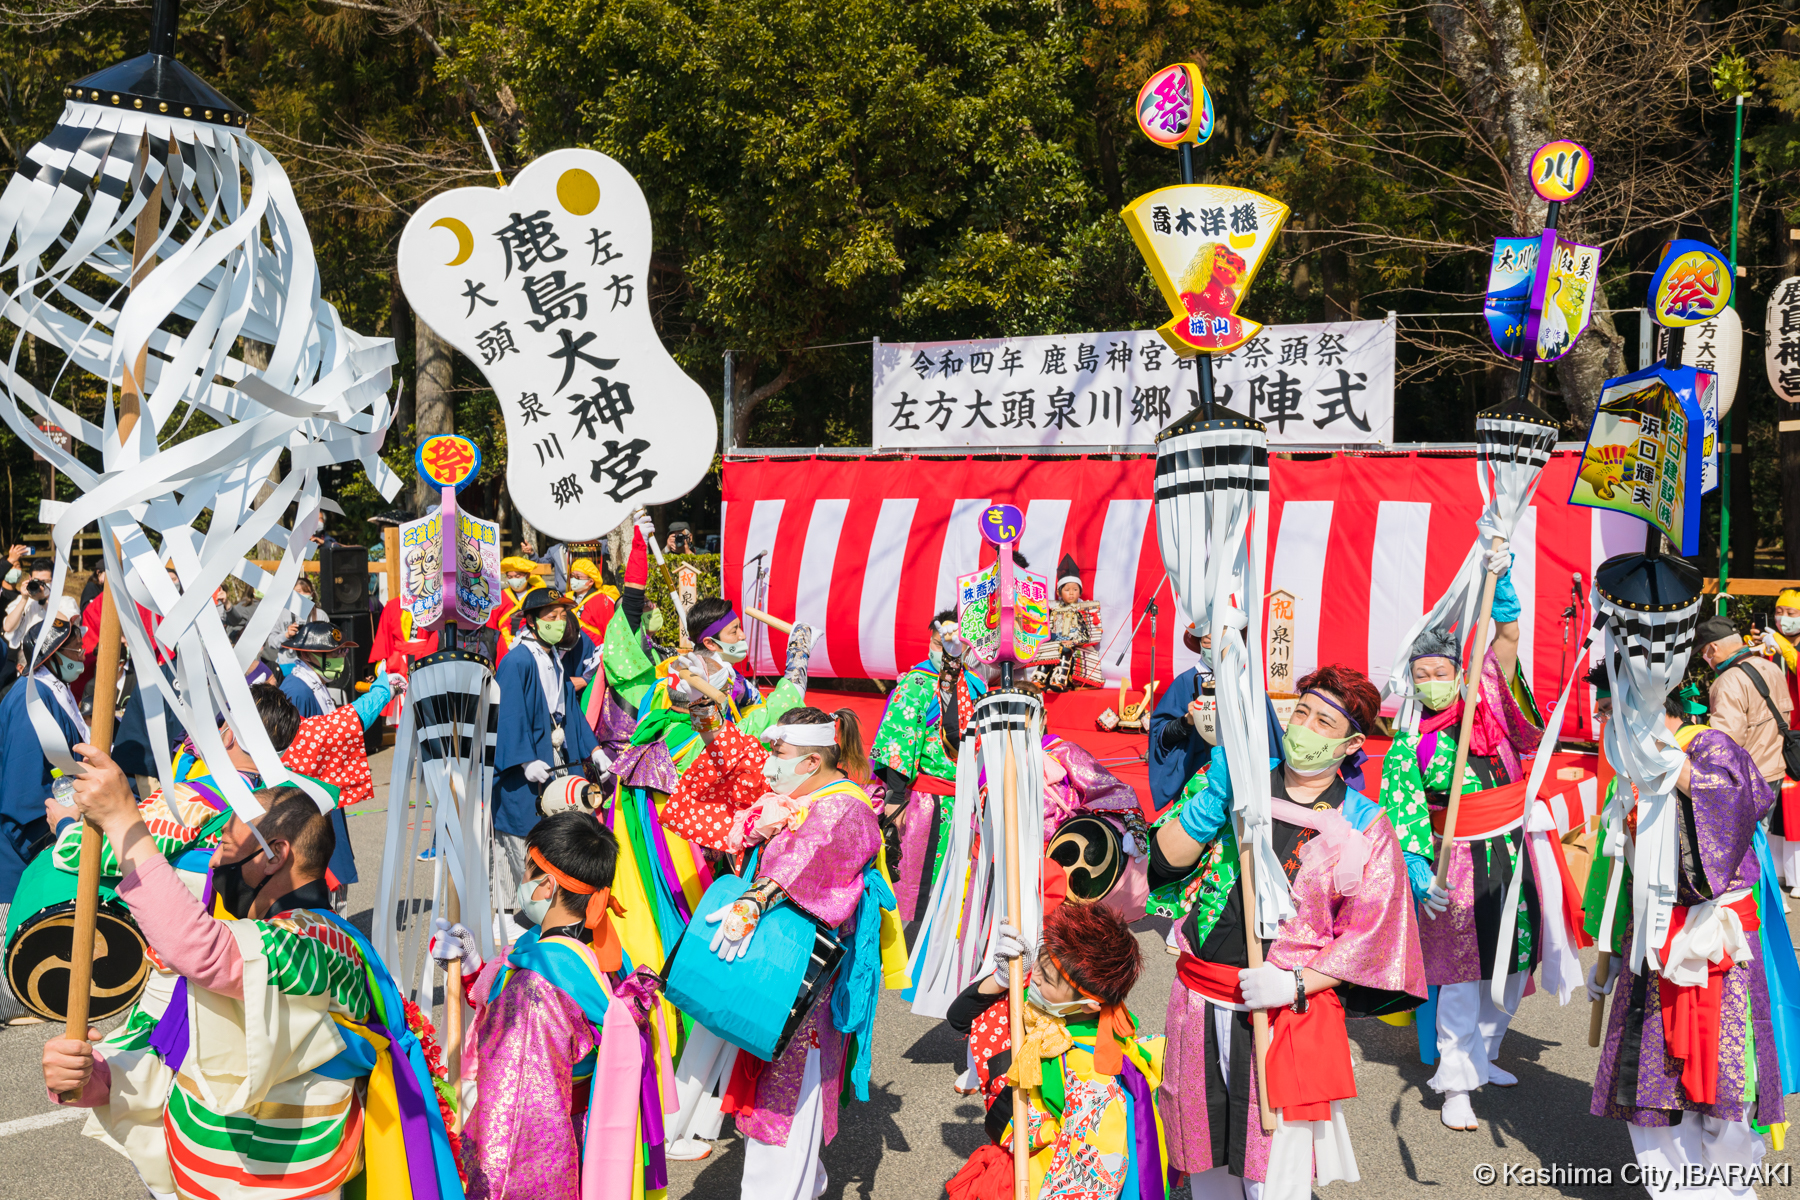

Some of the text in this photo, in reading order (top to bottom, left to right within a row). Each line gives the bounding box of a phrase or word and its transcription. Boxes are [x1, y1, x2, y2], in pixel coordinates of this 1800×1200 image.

[1147, 72, 1190, 130] 祭
[1538, 150, 1582, 193] 川
[1152, 202, 1259, 237] 喬木洋機
[585, 227, 634, 313] 左方
[1662, 258, 1719, 318] 祭
[461, 279, 520, 366] 大頭
[1190, 316, 1230, 336] 城山
[491, 210, 659, 504] 鹿島大神宮
[910, 332, 1348, 380] 令和四年 鹿島神宮祭頭祭
[424, 438, 474, 483] 祭
[517, 391, 584, 510] 泉川郷
[1633, 413, 1661, 511] 浜口輝夫
[1657, 411, 1685, 529] 浜口建設(株)
[404, 512, 443, 547] 三笠自動
[988, 509, 1016, 539] さい
[456, 583, 490, 609] 市宮中
[1270, 598, 1294, 680] 祝泉川郷
